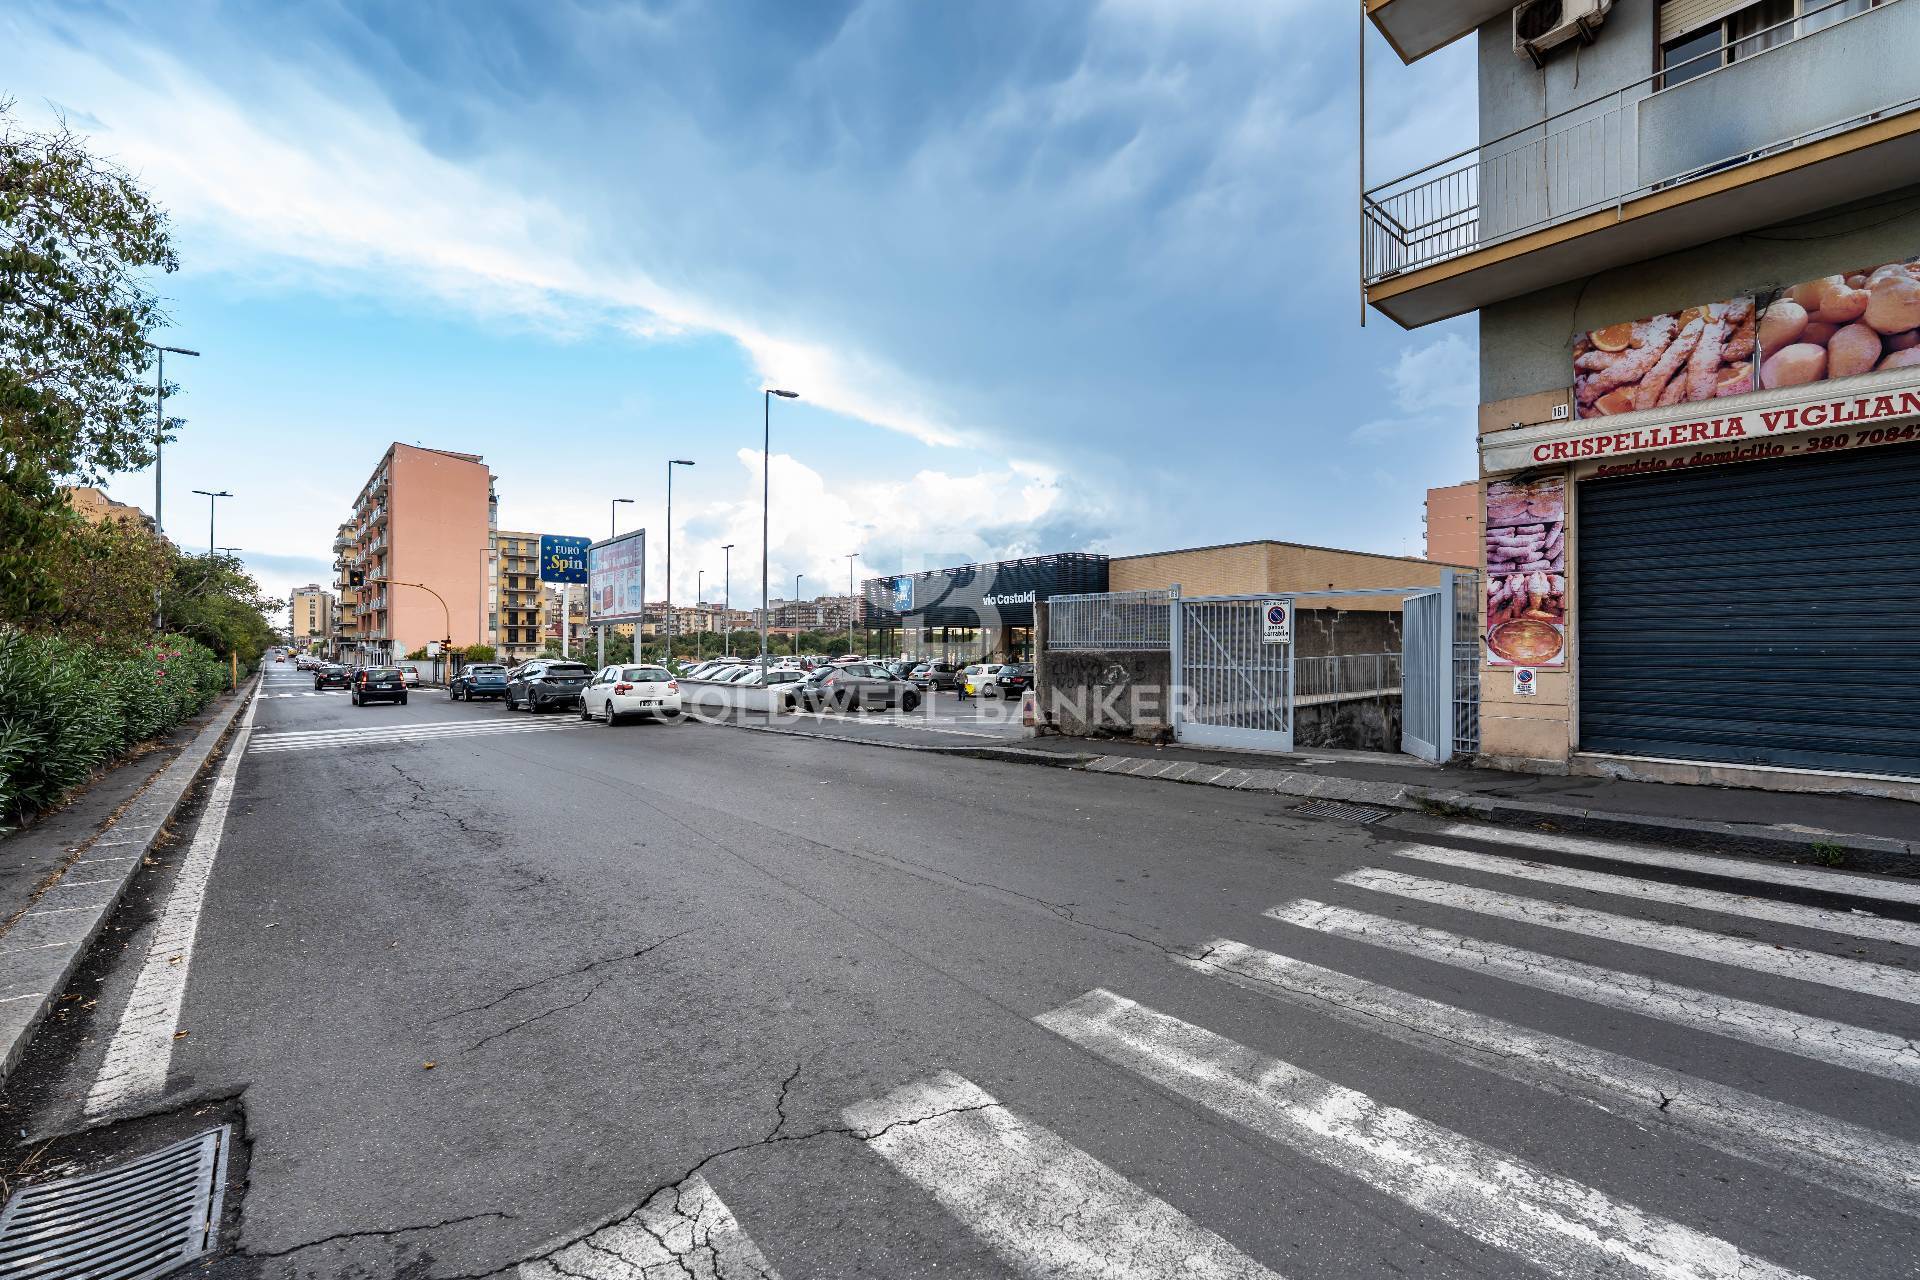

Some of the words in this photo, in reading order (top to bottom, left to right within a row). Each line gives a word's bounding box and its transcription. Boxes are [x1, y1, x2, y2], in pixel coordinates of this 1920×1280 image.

[1553, 405, 1567, 417] 161
[1533, 416, 1747, 462] CRISPELLERIA
[1672, 456, 1685, 468] a
[1690, 442, 1785, 466] domicilio
[1806, 433, 1850, 452] 380
[555, 545, 580, 555] EURO
[551, 555, 583, 572] Spin
[983, 593, 996, 606] via
[997, 590, 1036, 605] Castaldi
[1264, 629, 1289, 637] carrabile
